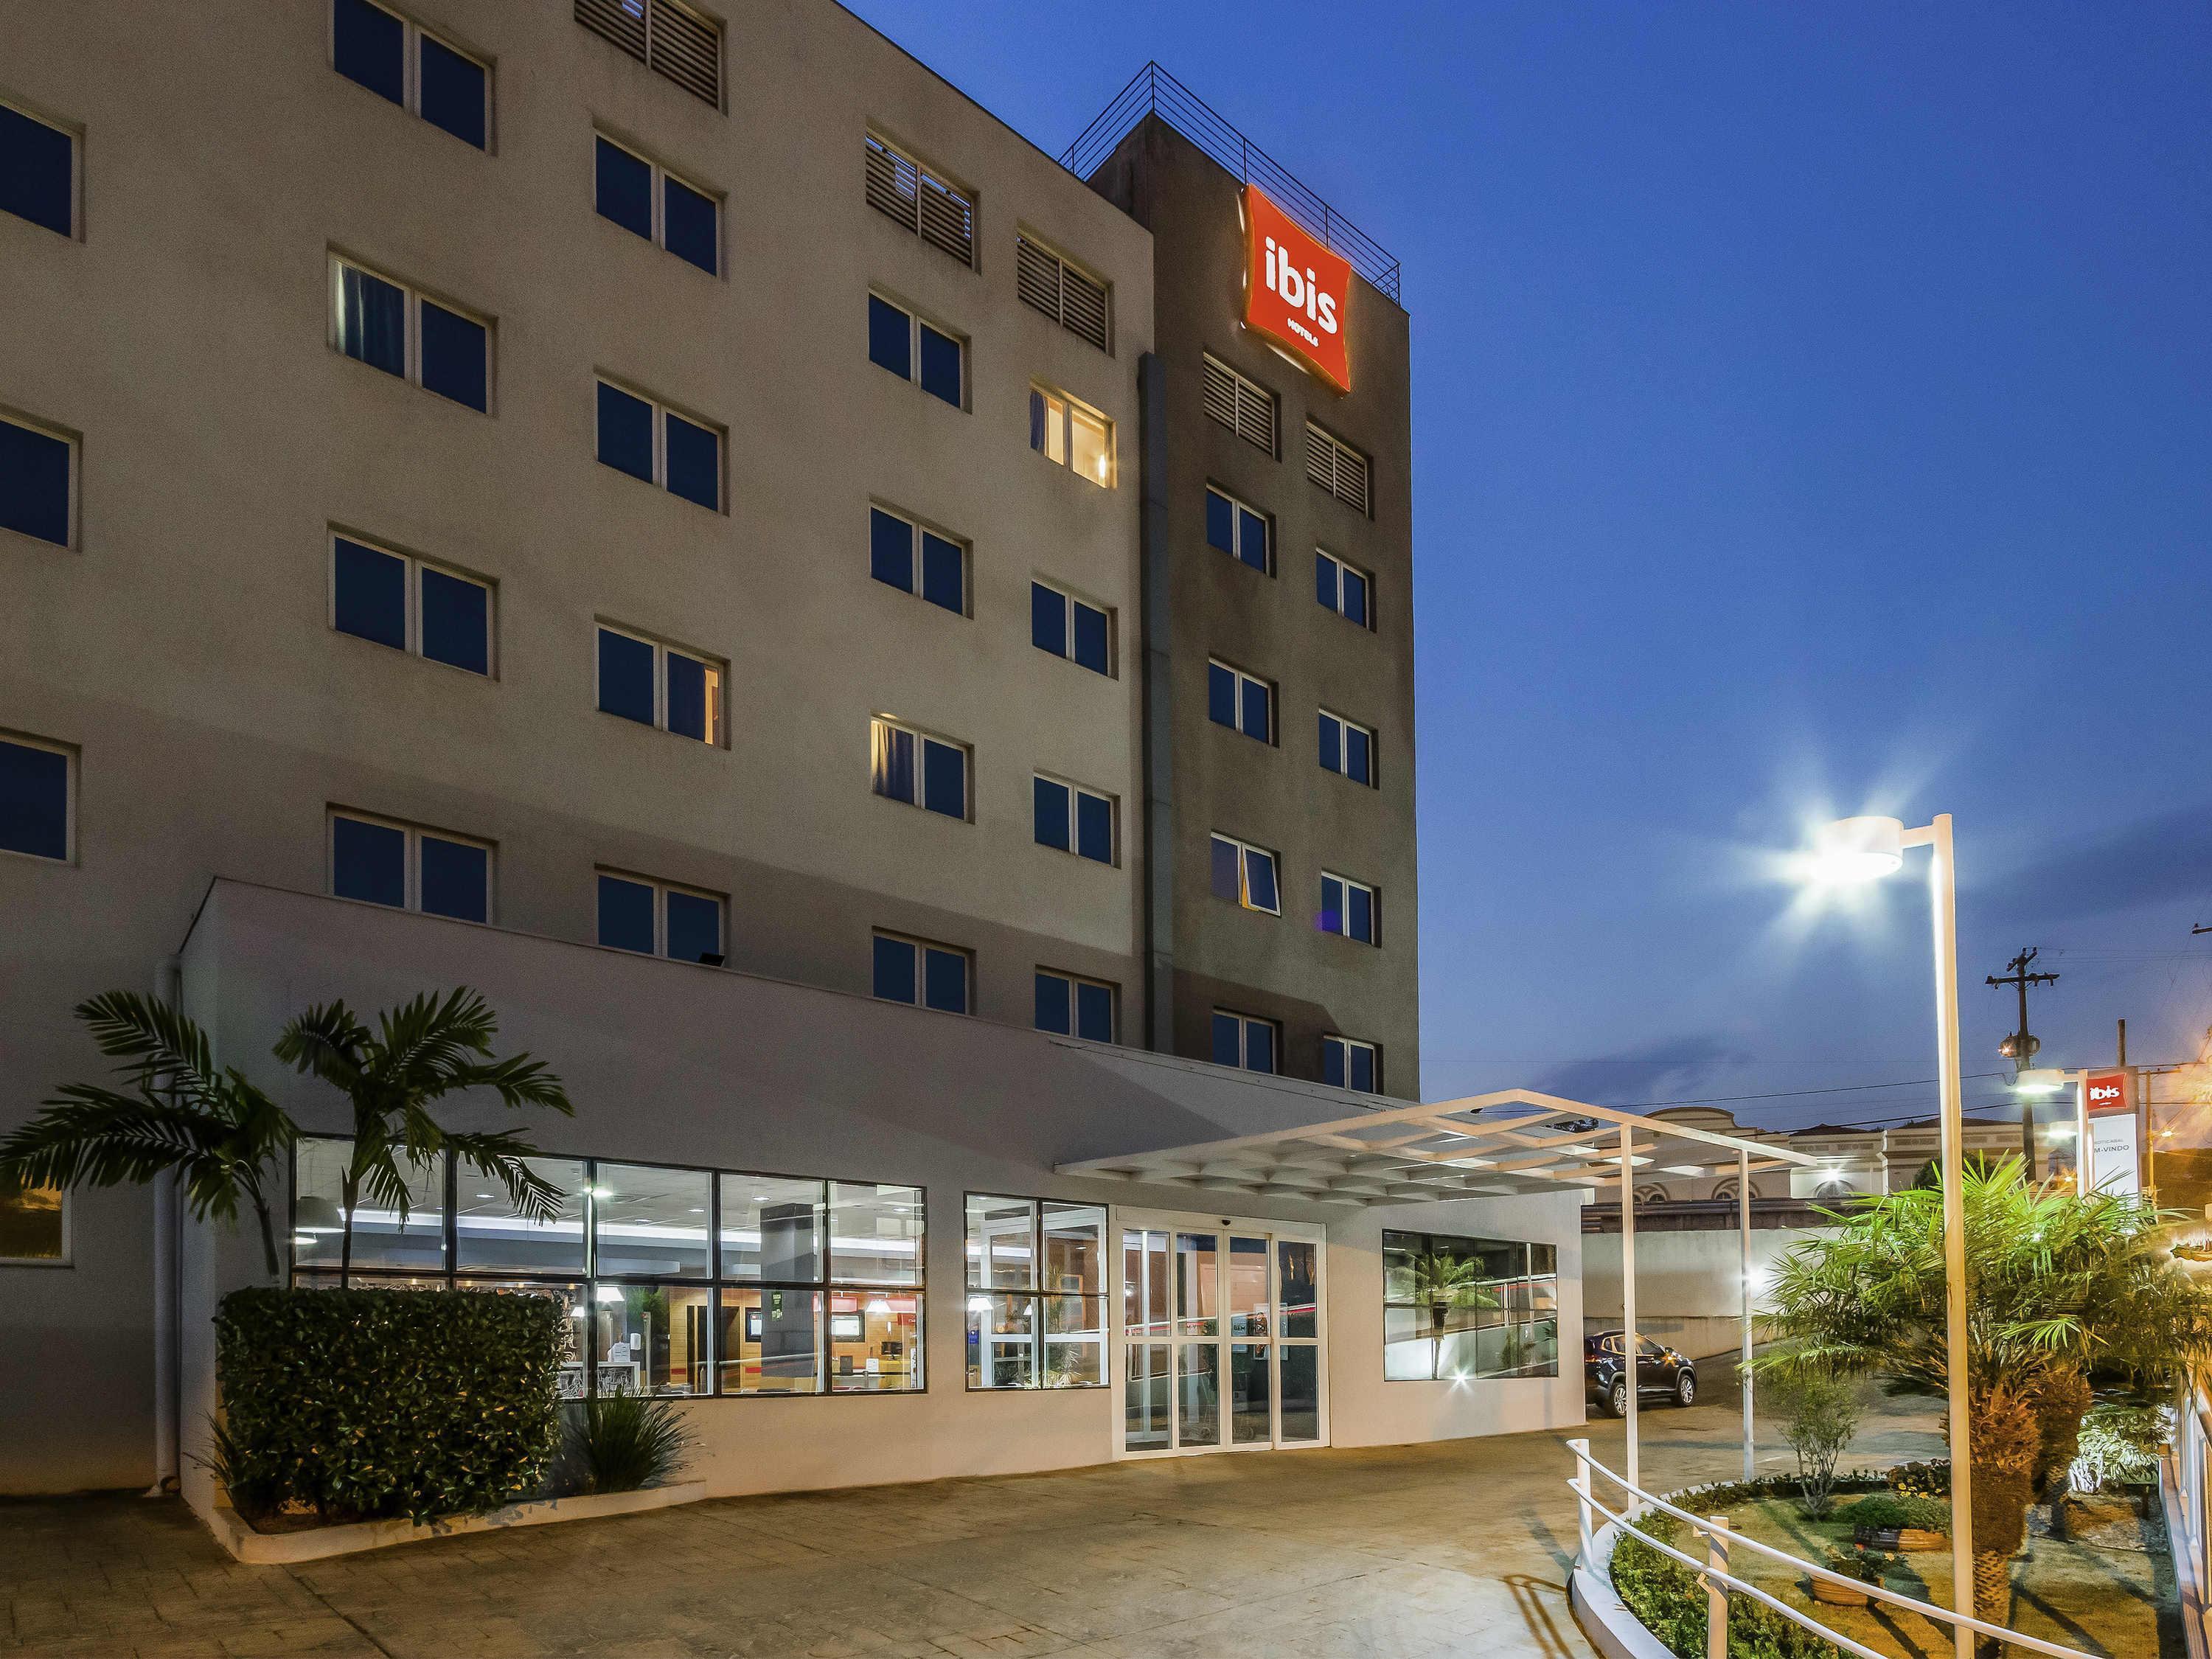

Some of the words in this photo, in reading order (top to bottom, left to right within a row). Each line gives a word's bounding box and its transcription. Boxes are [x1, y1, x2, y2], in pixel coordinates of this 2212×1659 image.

[1265, 237, 1338, 333] ibis
[1287, 318, 1319, 347] HOTELS
[2090, 1085, 2120, 1100] ibis
[2094, 1144, 2129, 1152] M-VINDO
